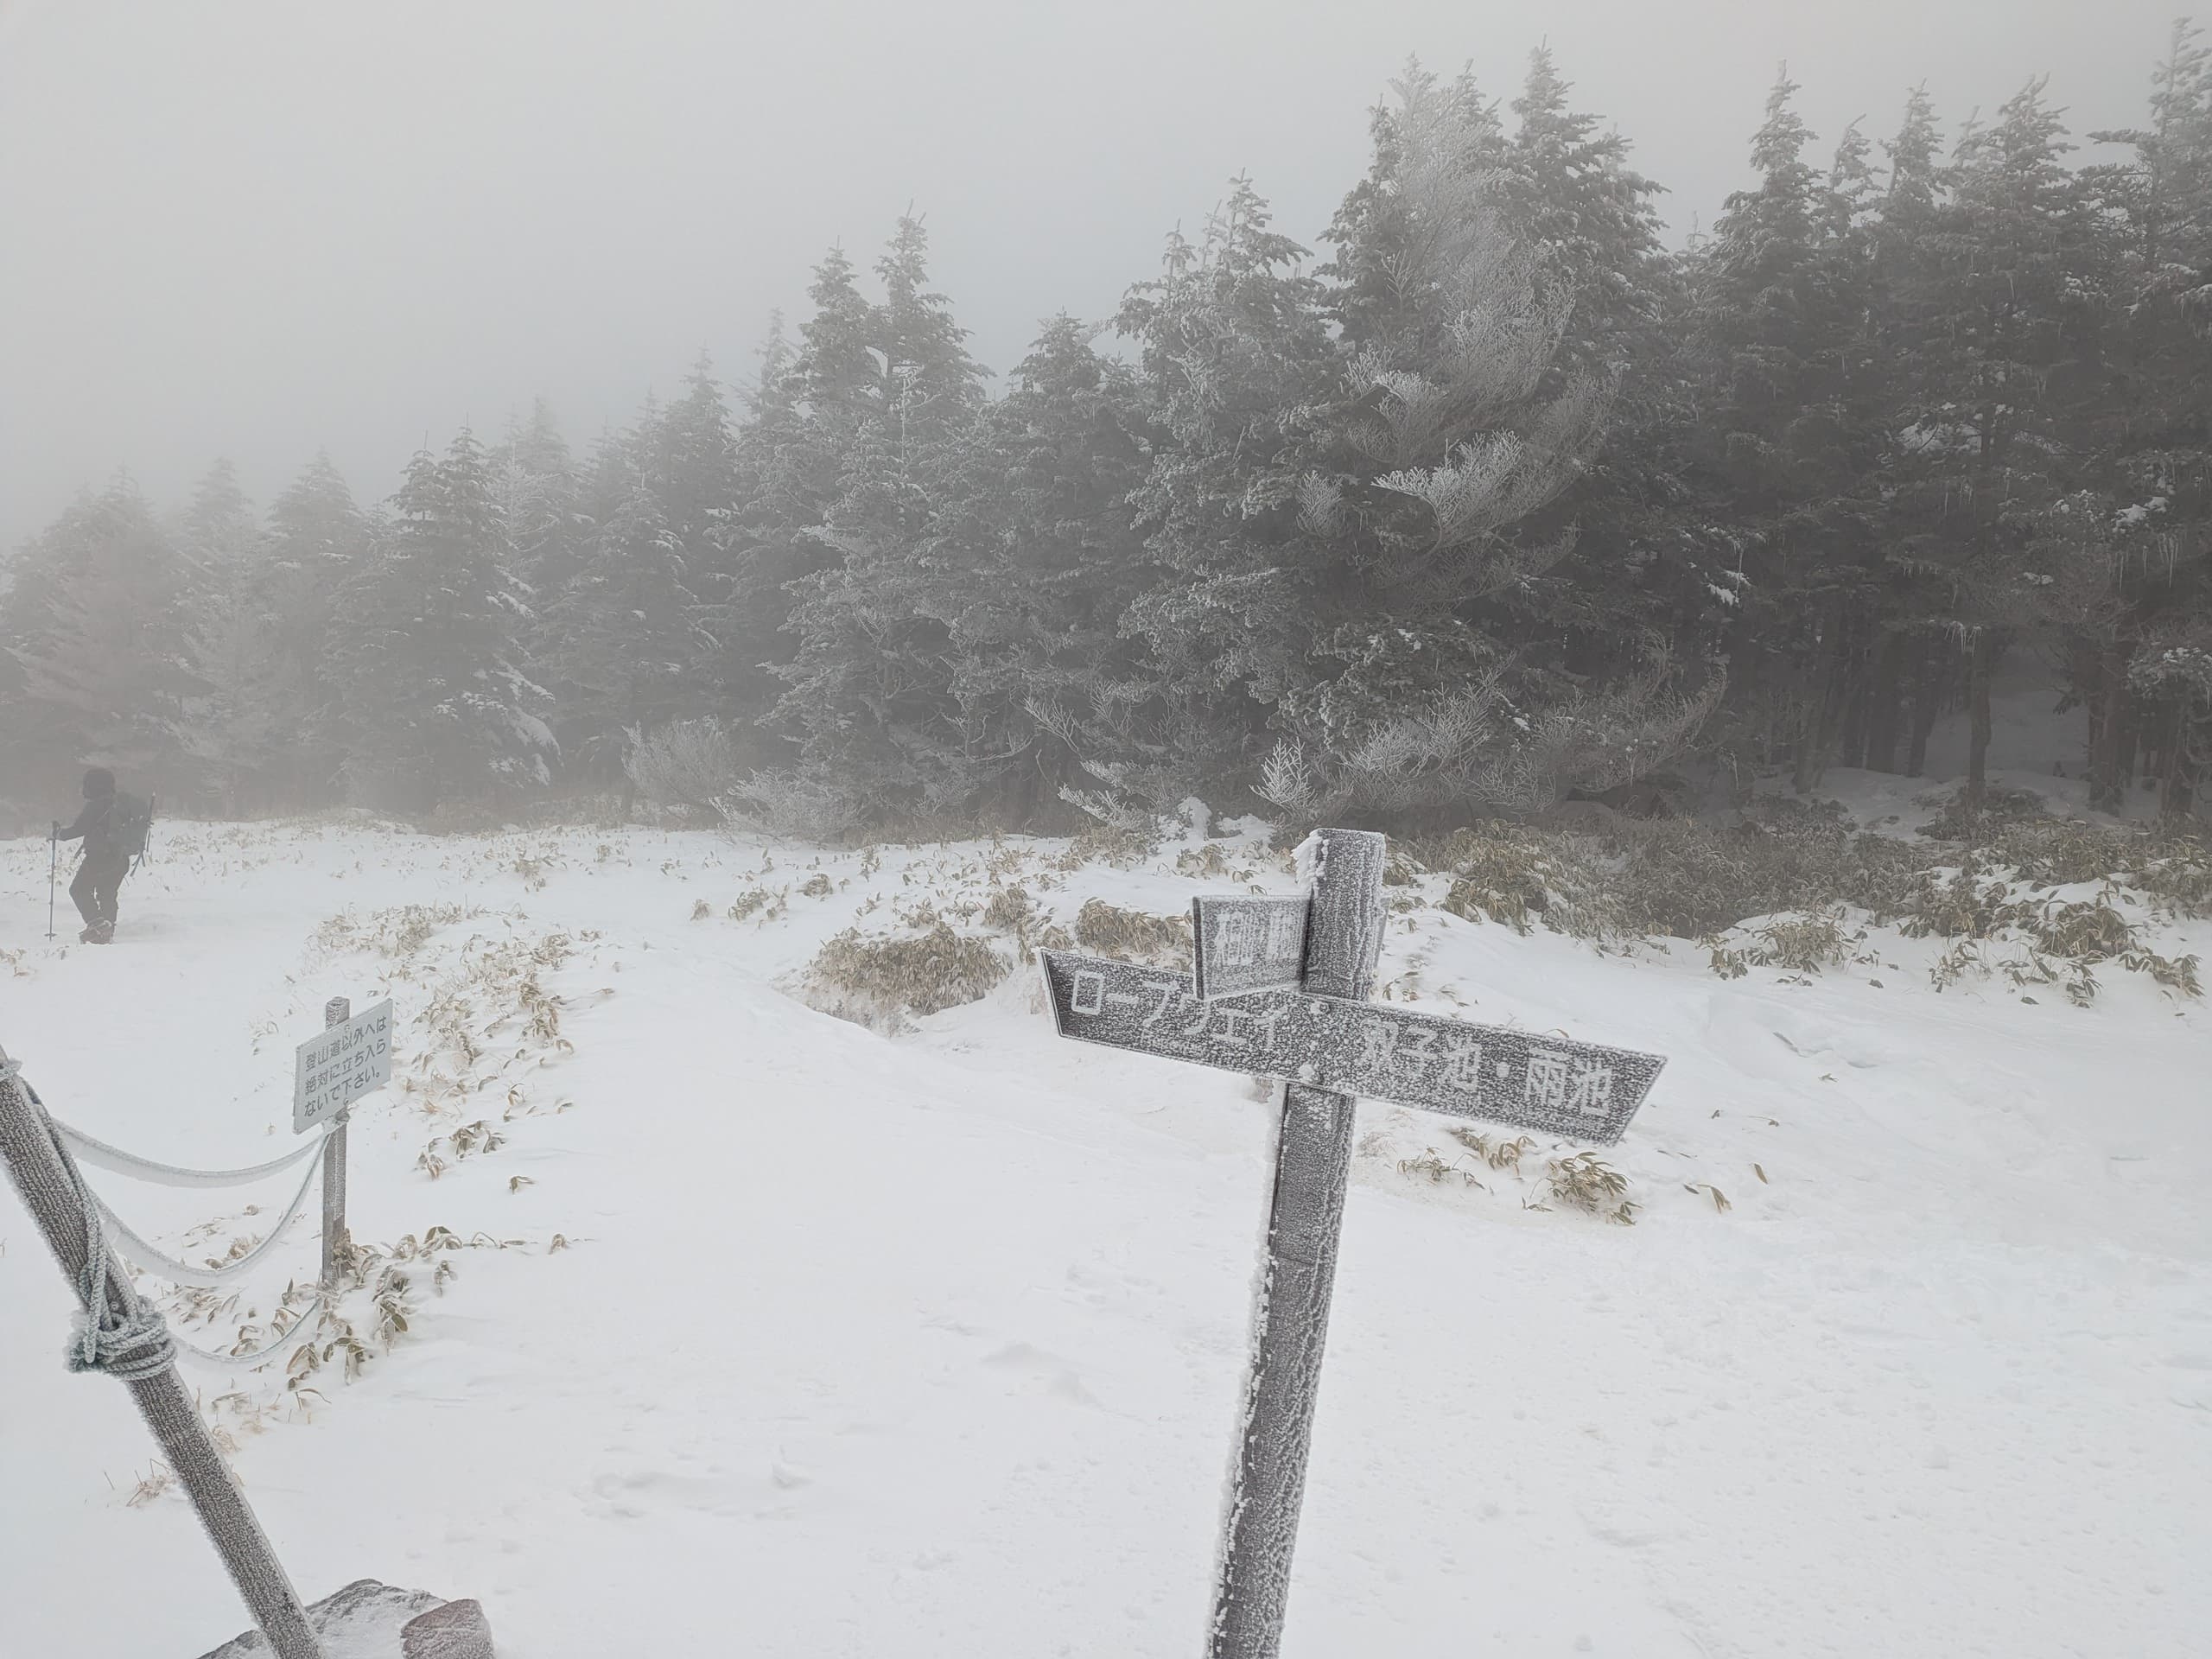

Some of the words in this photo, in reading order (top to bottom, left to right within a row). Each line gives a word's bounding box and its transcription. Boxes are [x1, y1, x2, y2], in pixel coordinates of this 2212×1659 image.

[304, 1039, 386, 1096] 絶対に立ち入ら
[305, 1015, 387, 1072] 登山道以外へは
[304, 1065, 380, 1117] ないで下さい。
